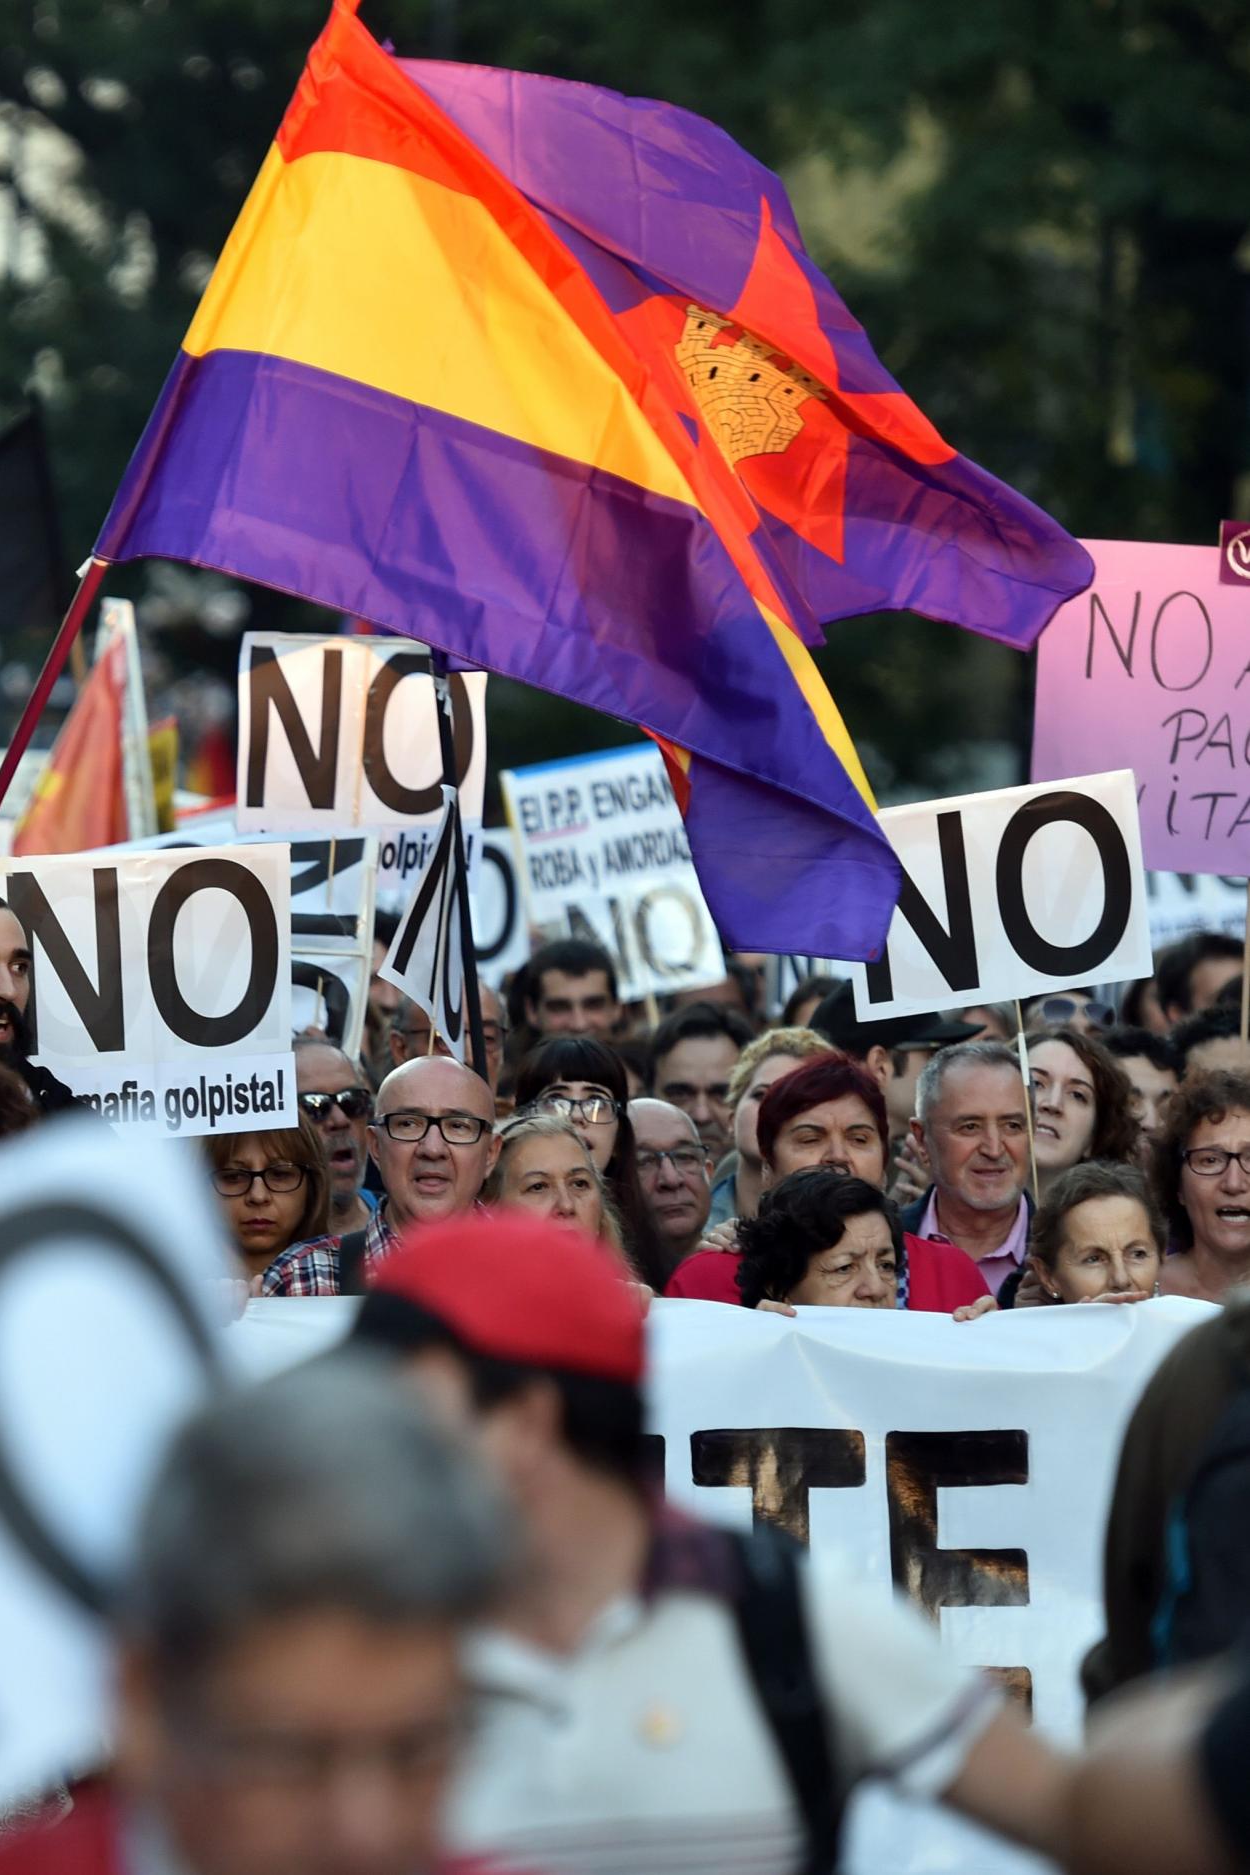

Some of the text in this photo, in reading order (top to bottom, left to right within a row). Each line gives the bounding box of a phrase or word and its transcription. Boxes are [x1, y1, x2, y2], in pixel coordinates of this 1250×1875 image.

[1086, 590, 1214, 692] NO
[246, 646, 474, 815] NO
[1162, 708, 1250, 769] PA
[6, 858, 278, 1055] NO
[865, 791, 1132, 1005] NO
[164, 1069, 285, 1131] golpista!
